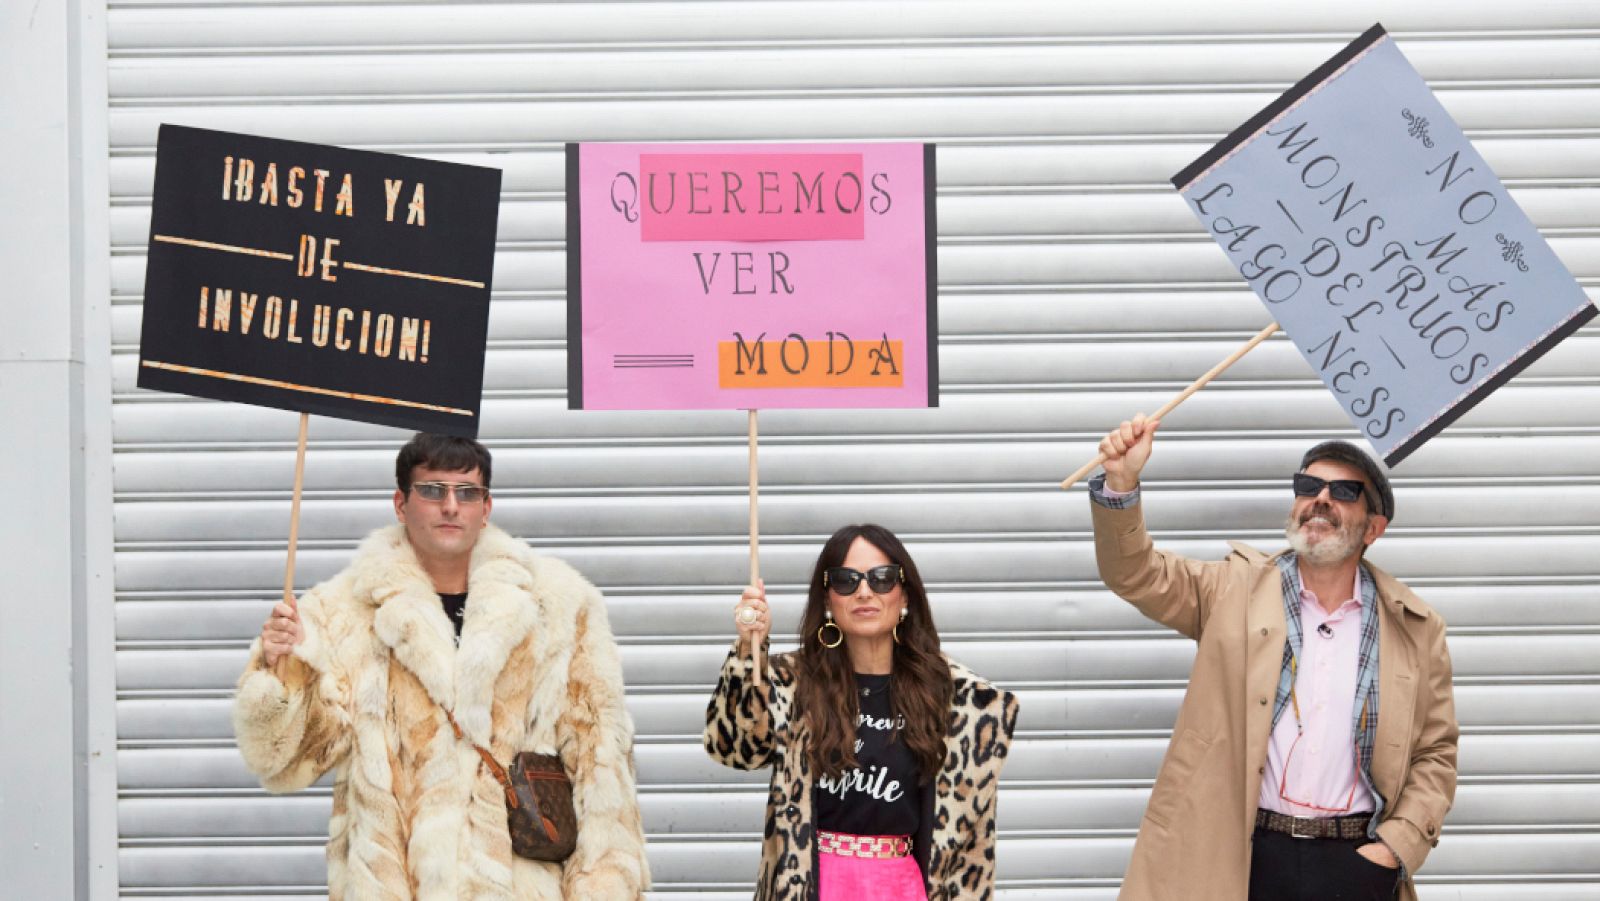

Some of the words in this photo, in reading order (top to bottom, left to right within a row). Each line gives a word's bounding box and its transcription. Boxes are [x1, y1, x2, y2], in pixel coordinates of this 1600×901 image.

[222, 156, 353, 217] ¡BASTA
[384, 179, 426, 227] YA
[610, 171, 892, 224] QUEREMOS
[1425, 151, 1498, 225] NO
[298, 234, 341, 282] DE
[692, 250, 795, 295] VER
[1266, 122, 1490, 385] MONSTRUOS
[1300, 238, 1385, 334] DEL
[198, 286, 431, 364] INVOLUCION!
[1192, 183, 1302, 304] LAGO
[1307, 330, 1406, 440] NESS
[732, 331, 901, 376] MODA
